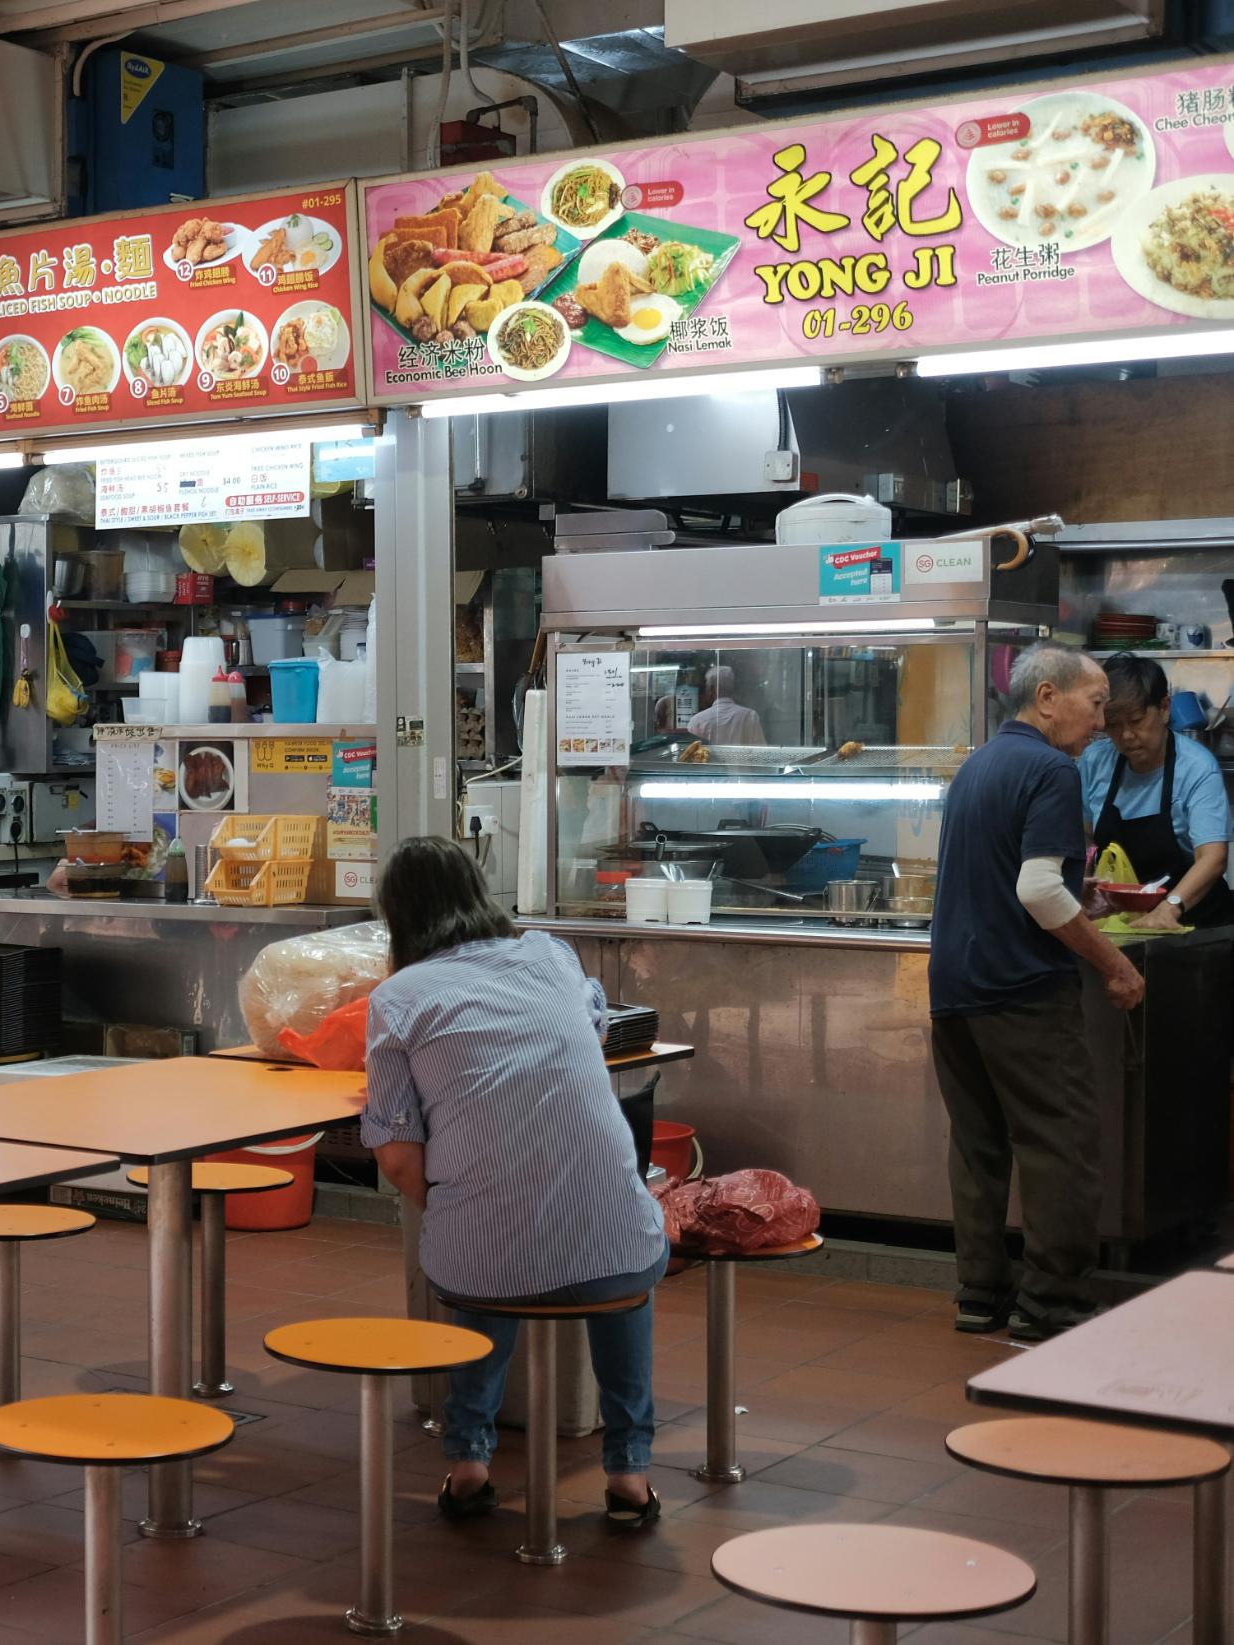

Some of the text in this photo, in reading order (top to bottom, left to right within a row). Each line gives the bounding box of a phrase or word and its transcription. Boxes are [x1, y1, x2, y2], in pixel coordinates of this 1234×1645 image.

[987, 120, 1019, 130] Lower in
[1155, 117, 1188, 131] Chee
[988, 128, 1018, 138] calories
[647, 188, 666, 196] Lower
[745, 133, 963, 252] 永記
[302, 194, 341, 209] #01-295
[991, 243, 1060, 270] 花生粥
[755, 245, 957, 303] YONG JI
[977, 266, 1075, 285] Peanut Porridge
[223, 277, 236, 286] Wing
[294, 284, 307, 292] Wing
[30, 296, 57, 314] FISH
[58, 291, 90, 310] SOUP
[102, 283, 156, 304] NOODLE
[802, 301, 913, 339] 01-296
[668, 316, 729, 341] 椰浆饭
[668, 337, 732, 354] Nasi Lemak
[398, 339, 485, 369] 经济米粉
[386, 363, 503, 385] Economic Bee Hoon
[254, 390, 267, 398] Soup
[223, 477, 241, 485] $4.00
[263, 492, 301, 504] SELF-SERVICE
[835, 550, 878, 564] CDC Voucher
[918, 558, 972, 568] SG CLEAN
[834, 568, 867, 581] Accepted
[850, 578, 867, 587] here
